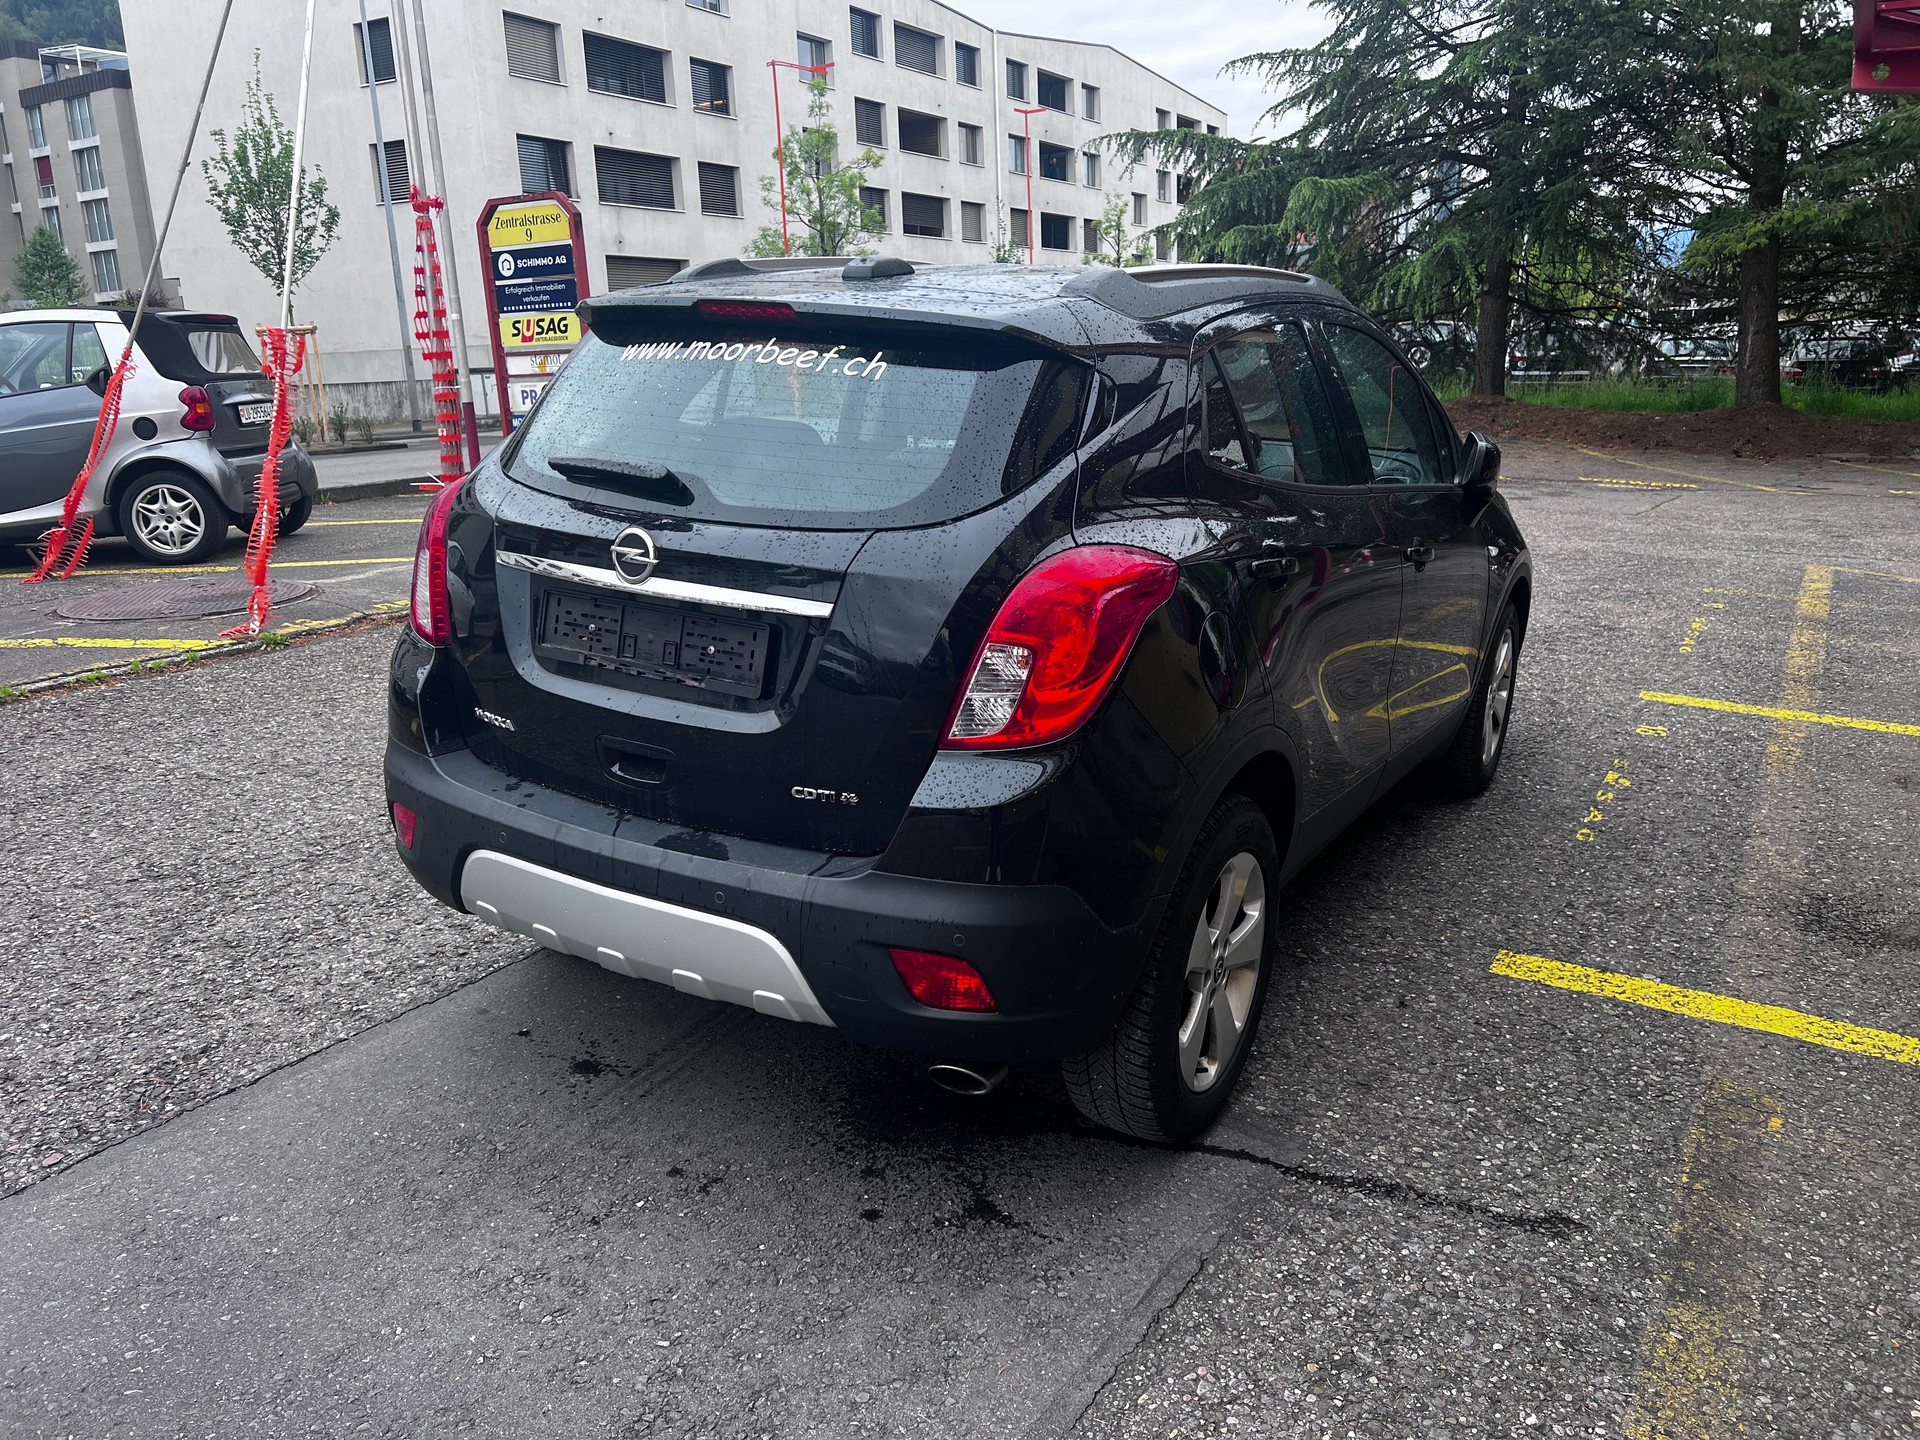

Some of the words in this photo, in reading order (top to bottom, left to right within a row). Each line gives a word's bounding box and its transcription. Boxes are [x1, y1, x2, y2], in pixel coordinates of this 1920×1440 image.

[495, 213, 562, 230] Zentralstrasse
[525, 228, 532, 242] 9
[517, 256, 554, 268] SCHIMMO
[555, 255, 567, 265] AG
[505, 286, 535, 295] Erfolgreich
[535, 283, 566, 292] Immobilien
[522, 294, 550, 302] verkaufen
[512, 316, 569, 338] SUSAG
[620, 337, 888, 381] www.moorbeef.ch
